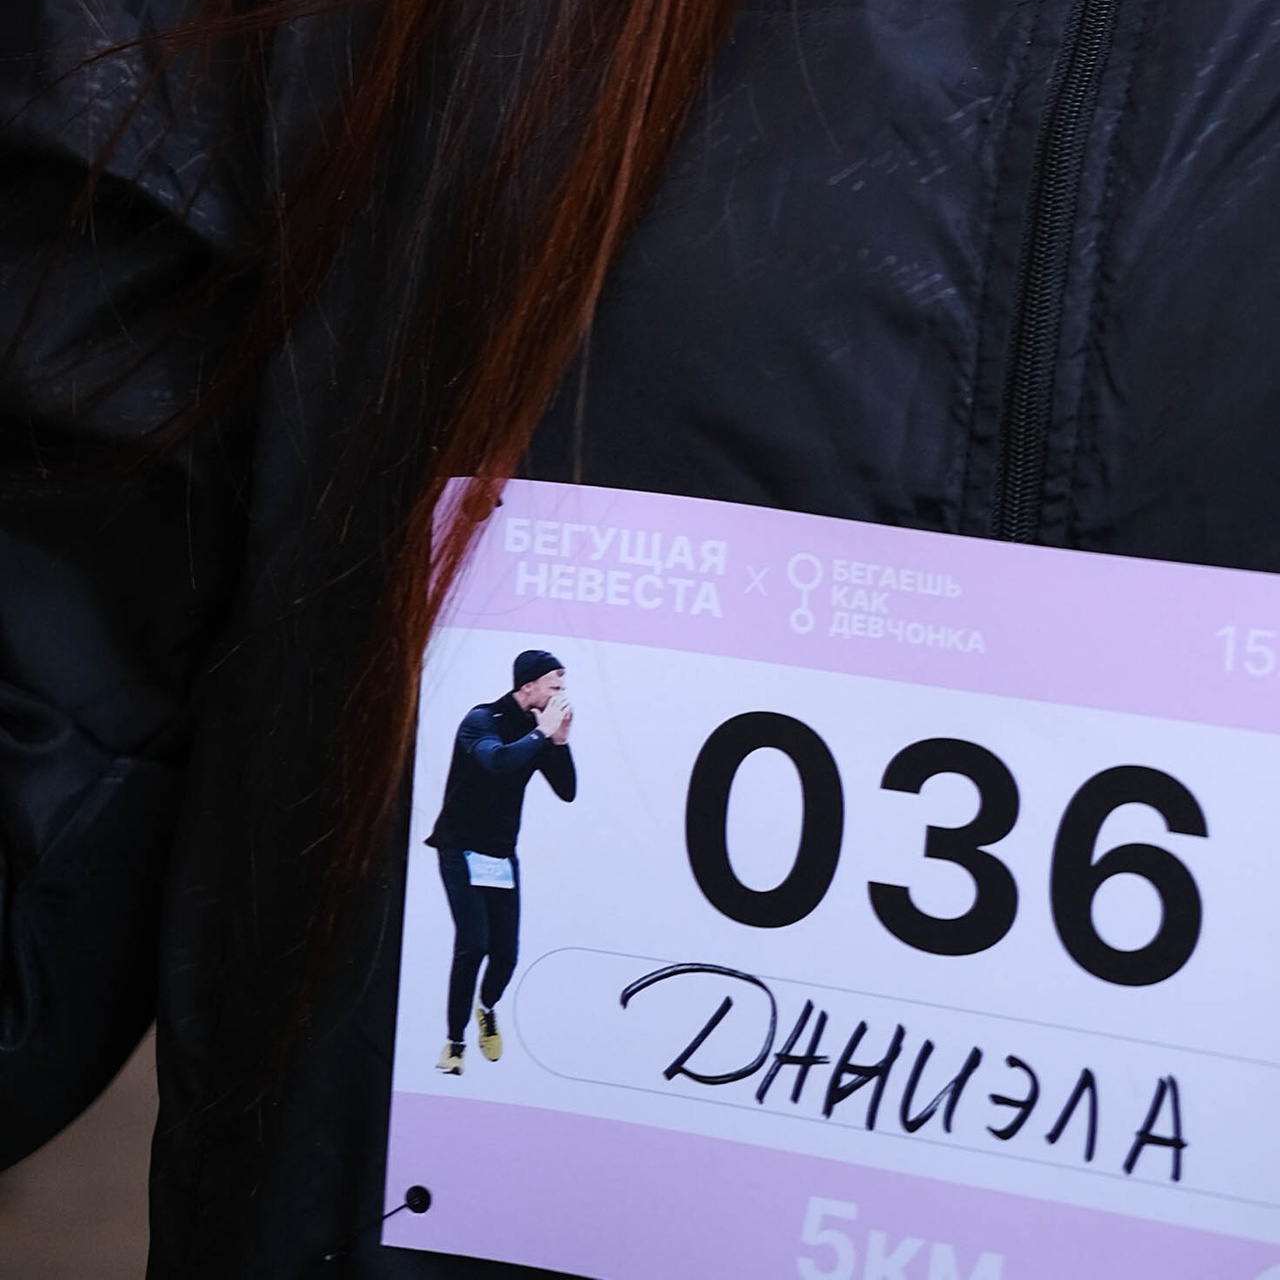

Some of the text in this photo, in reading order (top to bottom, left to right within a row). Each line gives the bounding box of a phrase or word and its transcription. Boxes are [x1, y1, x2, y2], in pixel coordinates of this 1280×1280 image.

[505, 517, 727, 575] БЕГУЩАЯ
[515, 561, 722, 618] НЕВЕСТА
[831, 559, 962, 598] БЕГАЕШЬ
[831, 586, 889, 614] КАК
[828, 611, 986, 654] ДЕВЧОНКА
[684, 710, 1210, 987] 036
[620, 962, 1188, 1182] ДАНИЭЛА
